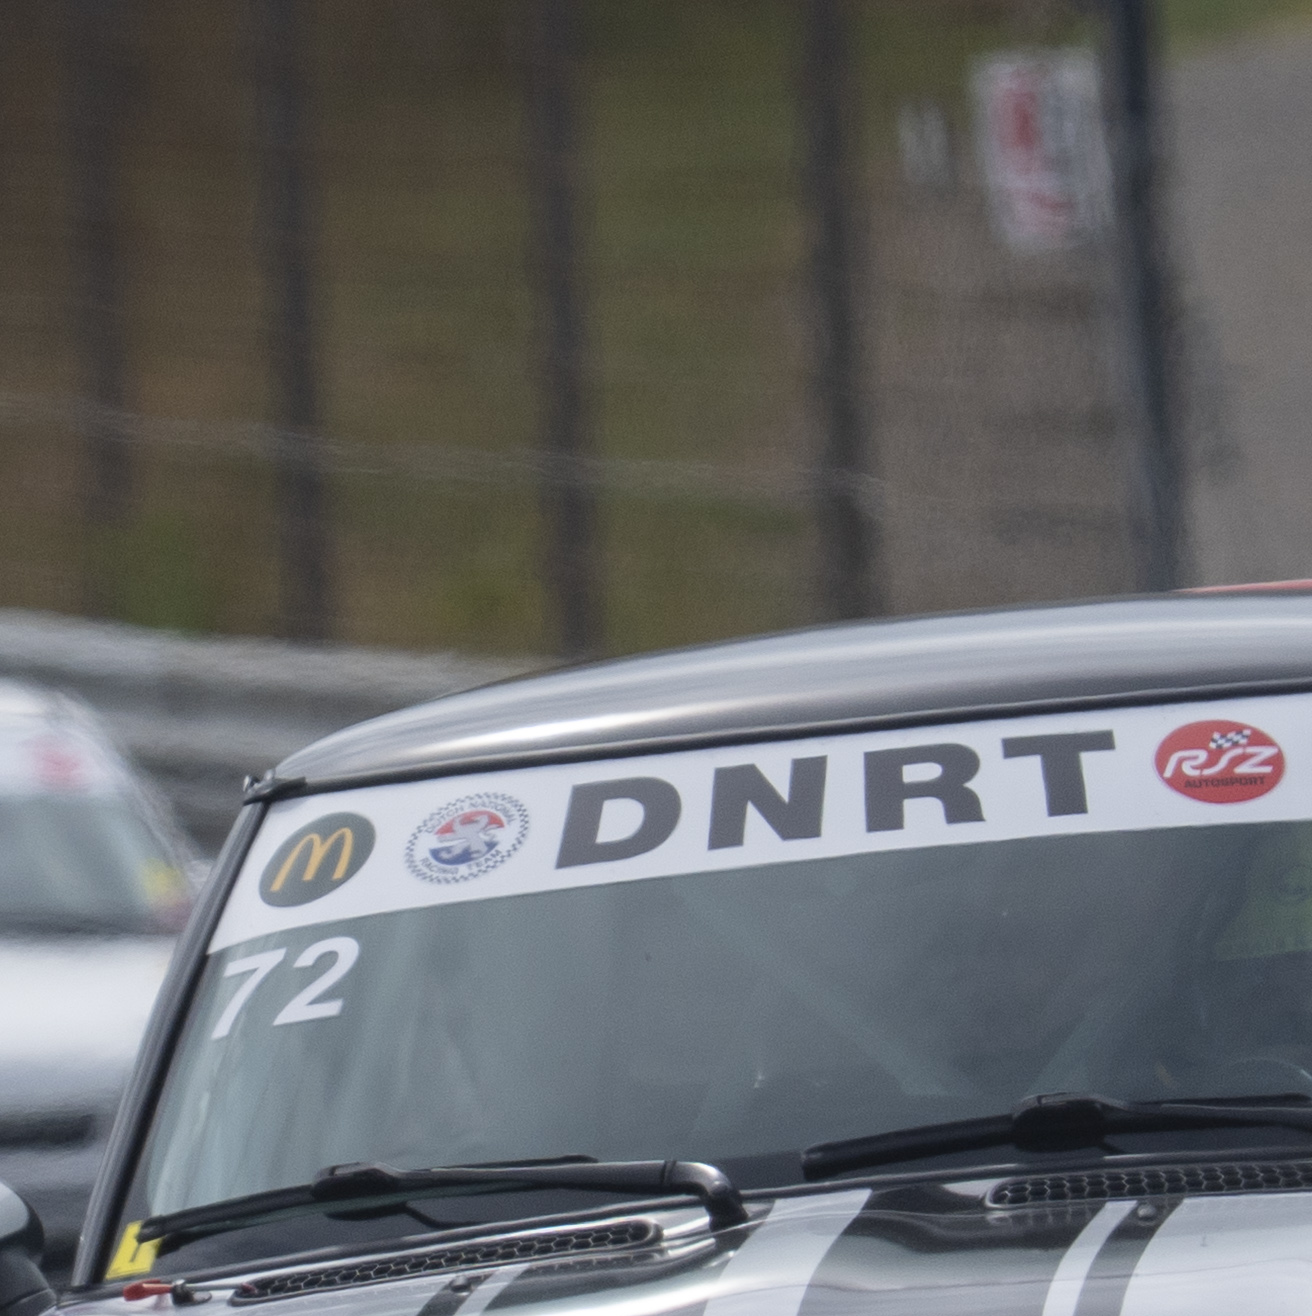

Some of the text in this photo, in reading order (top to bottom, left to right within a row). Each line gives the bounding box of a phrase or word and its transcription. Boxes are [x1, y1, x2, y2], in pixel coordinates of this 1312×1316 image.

[555, 729, 1116, 869] DNRT
[1184, 776, 1266, 789] AUTOSPORT
[424, 799, 517, 834] DUTCH NATIONAL
[418, 848, 503, 876] RACING TEAM
[211, 935, 360, 1041] 72
